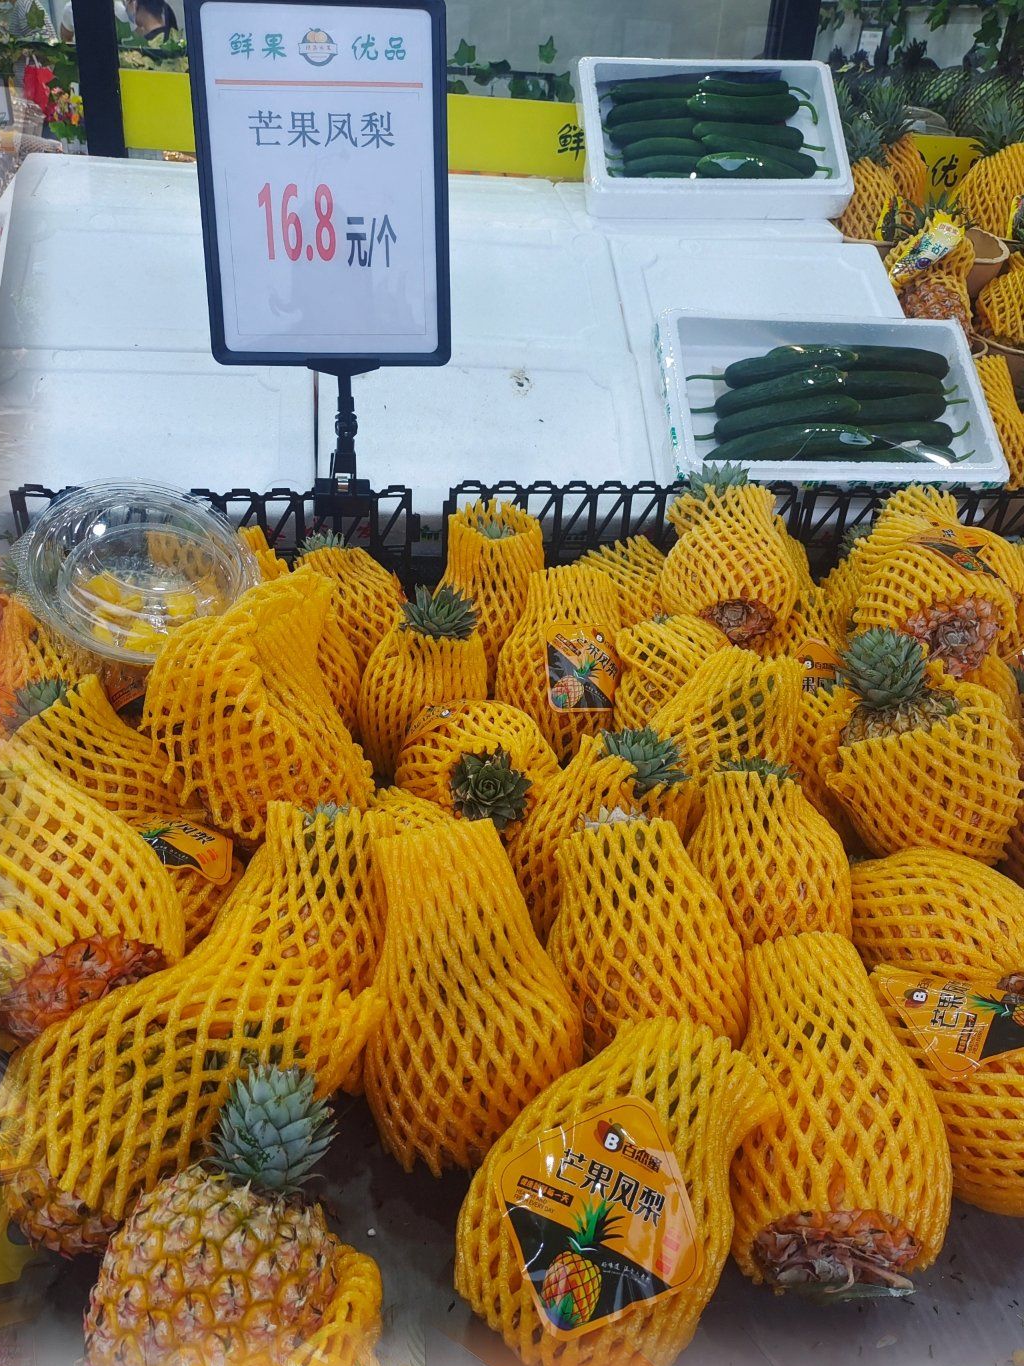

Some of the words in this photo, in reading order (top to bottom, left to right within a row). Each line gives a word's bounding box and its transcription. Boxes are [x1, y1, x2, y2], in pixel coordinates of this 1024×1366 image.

[228, 32, 287, 61] 鲜果
[351, 34, 406, 61] 优品
[248, 110, 395, 149] 芒果凤梨
[555, 1148, 666, 1228] 芒果凤梨
